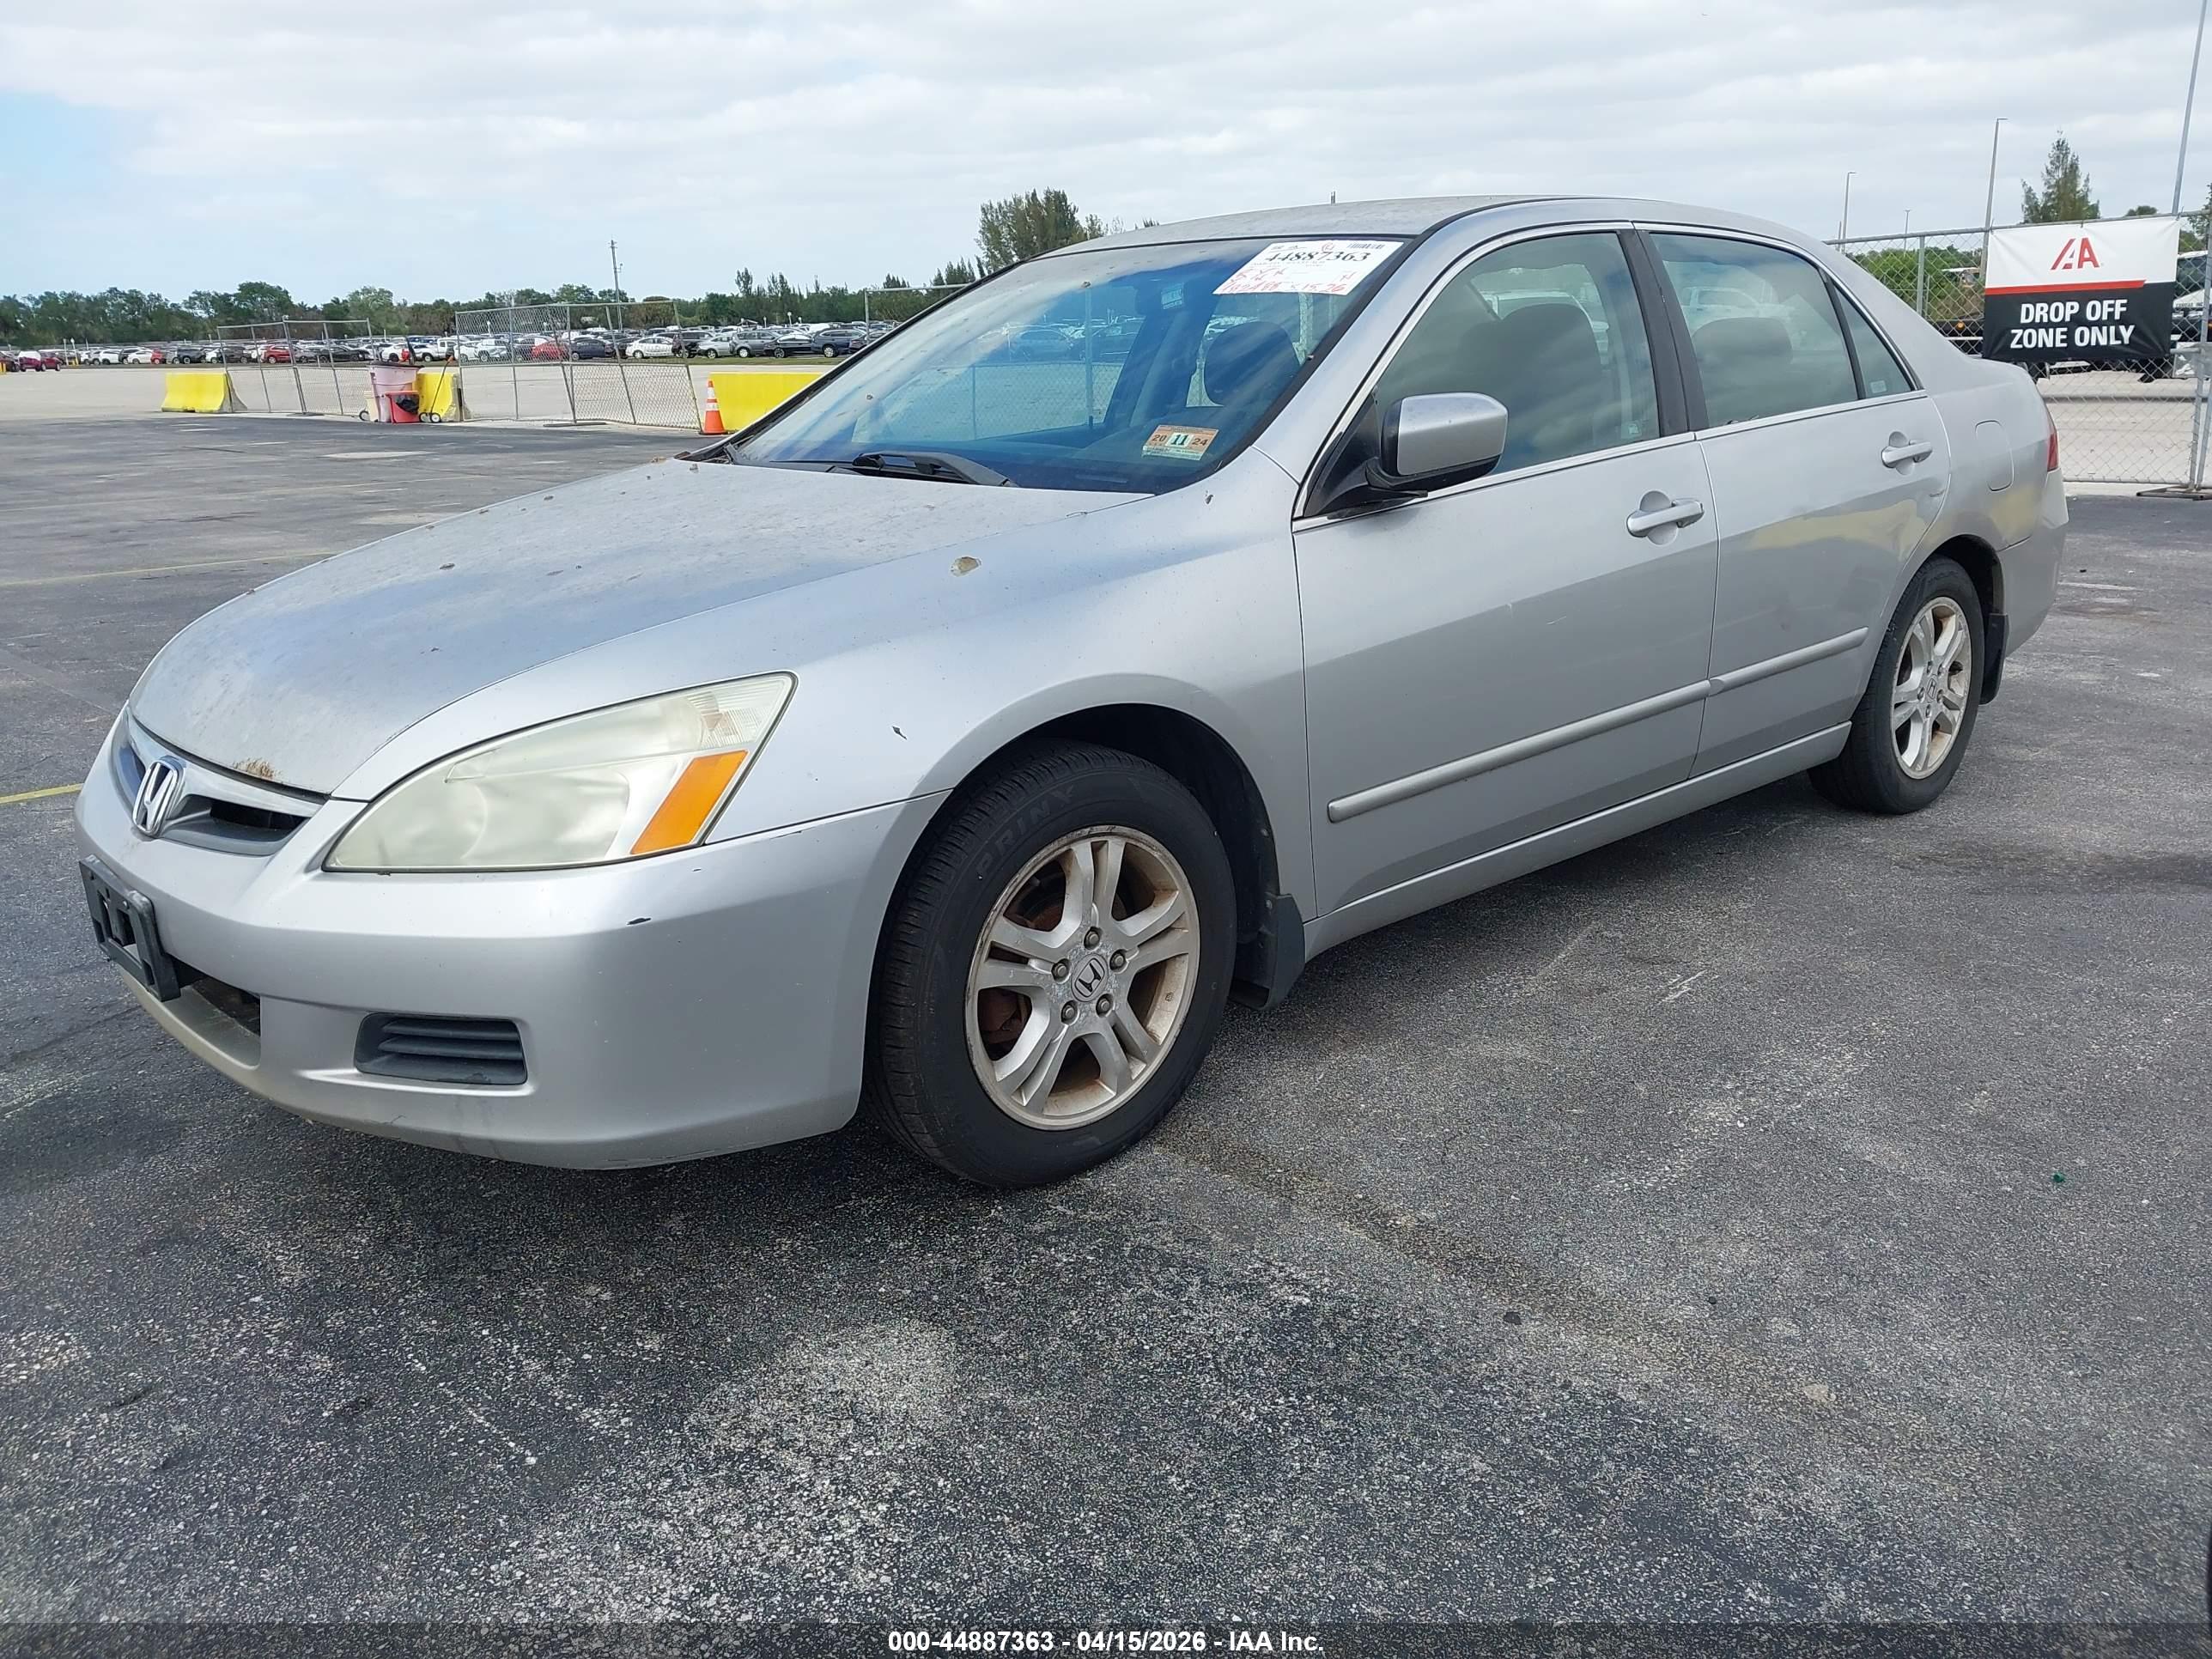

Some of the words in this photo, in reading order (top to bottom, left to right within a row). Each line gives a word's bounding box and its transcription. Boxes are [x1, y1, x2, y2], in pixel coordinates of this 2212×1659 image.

[1265, 251, 1371, 262] 44887363
[2020, 302, 2080, 324] DROP
[2086, 299, 2128, 320] OFF
[2010, 328, 2068, 349] ZONE
[2075, 325, 2136, 346] ONLY
[1152, 434, 1167, 442] 20
[1170, 434, 1188, 446] 11
[1192, 438, 1208, 447] 24
